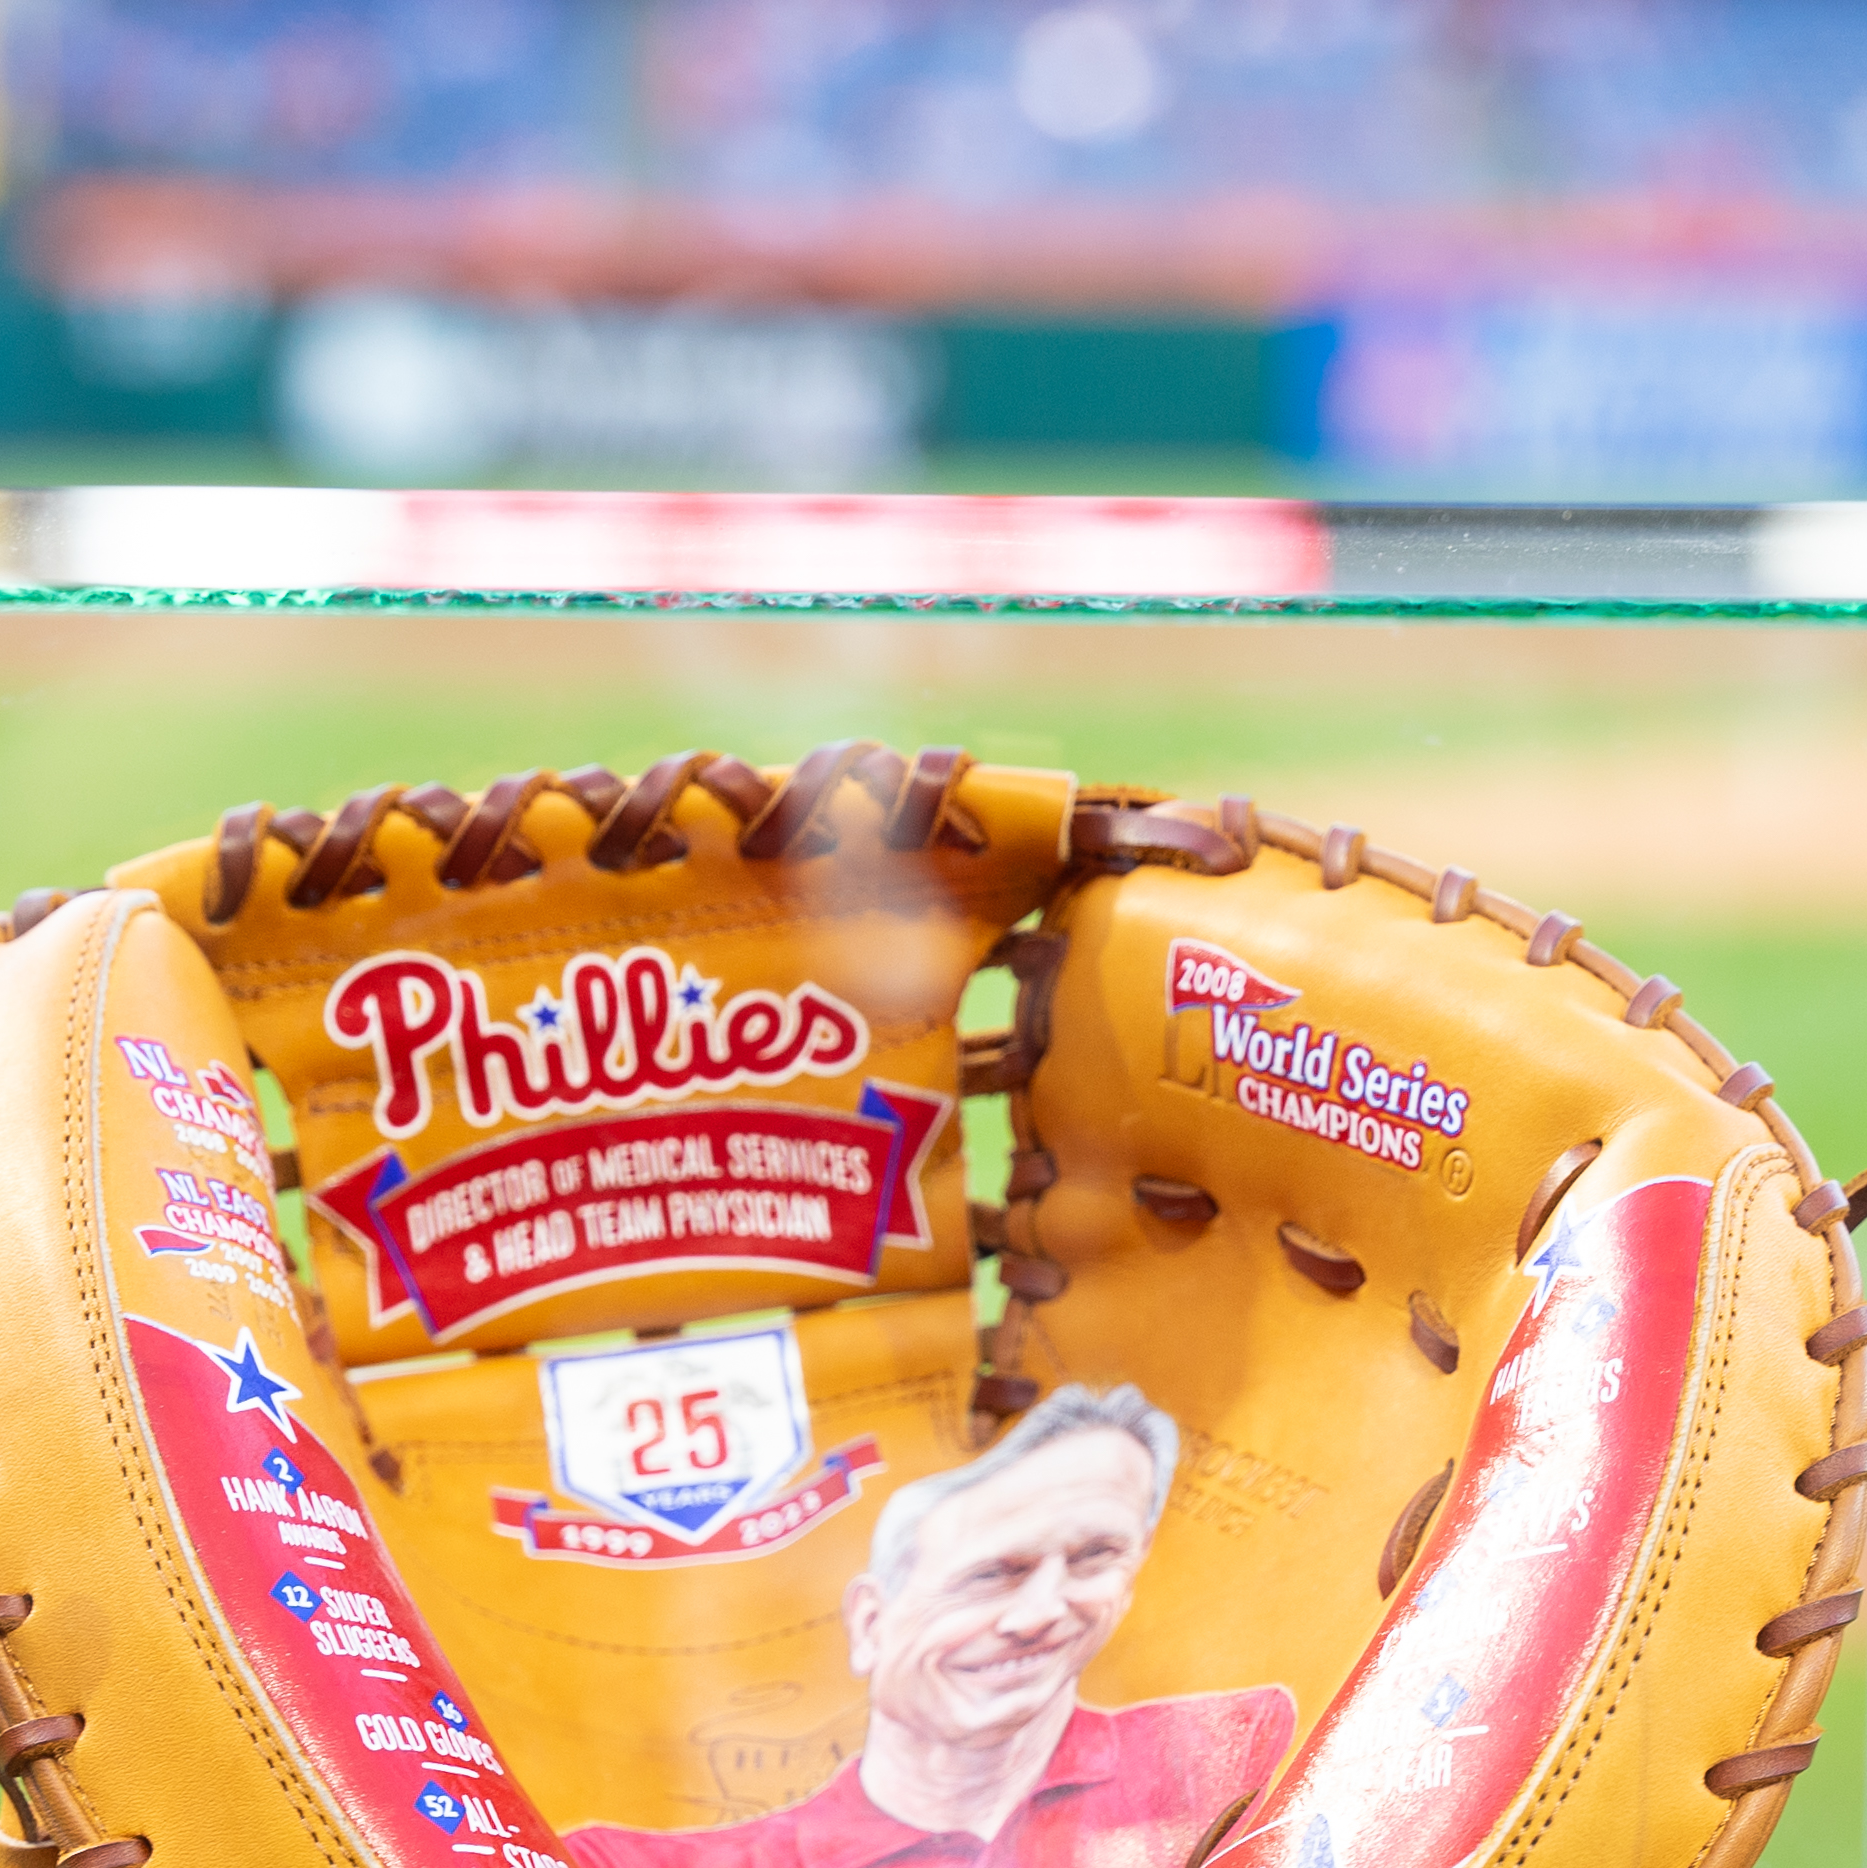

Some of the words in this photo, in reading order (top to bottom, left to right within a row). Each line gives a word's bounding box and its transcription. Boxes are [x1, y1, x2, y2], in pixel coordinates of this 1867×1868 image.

[1176, 958, 1248, 1003] 2008
[118, 1038, 187, 1086] NL
[327, 950, 865, 1135] Phillies
[1212, 1004, 1336, 1089] World
[1340, 1046, 1468, 1136] Series
[1238, 1076, 1422, 1169] CHAMPIONS
[159, 1170, 210, 1207] NL
[406, 1158, 548, 1254] DIRECTOR
[552, 1154, 586, 1196] OF
[588, 1133, 723, 1191] MEDICAL
[726, 1131, 873, 1195] SERVICES
[463, 1242, 492, 1285] &
[492, 1207, 576, 1277] HEAD
[580, 1196, 666, 1250] TEAM
[667, 1192, 831, 1242] PHYSICIAN
[626, 1389, 729, 1477] 25
[273, 1456, 294, 1482] 2
[221, 1476, 296, 1518] HANK
[301, 1490, 368, 1539] AARON
[278, 1522, 347, 1555] AWARDS
[559, 1523, 654, 1559] 1999
[281, 1585, 314, 1609] 12
[320, 1586, 393, 1629] SILVER
[310, 1621, 420, 1668] SLUGGERS
[356, 1713, 426, 1753] GOLD
[425, 1720, 504, 1775] GLOVES
[424, 1794, 459, 1818] 52
[462, 1795, 520, 1838] ALL-
